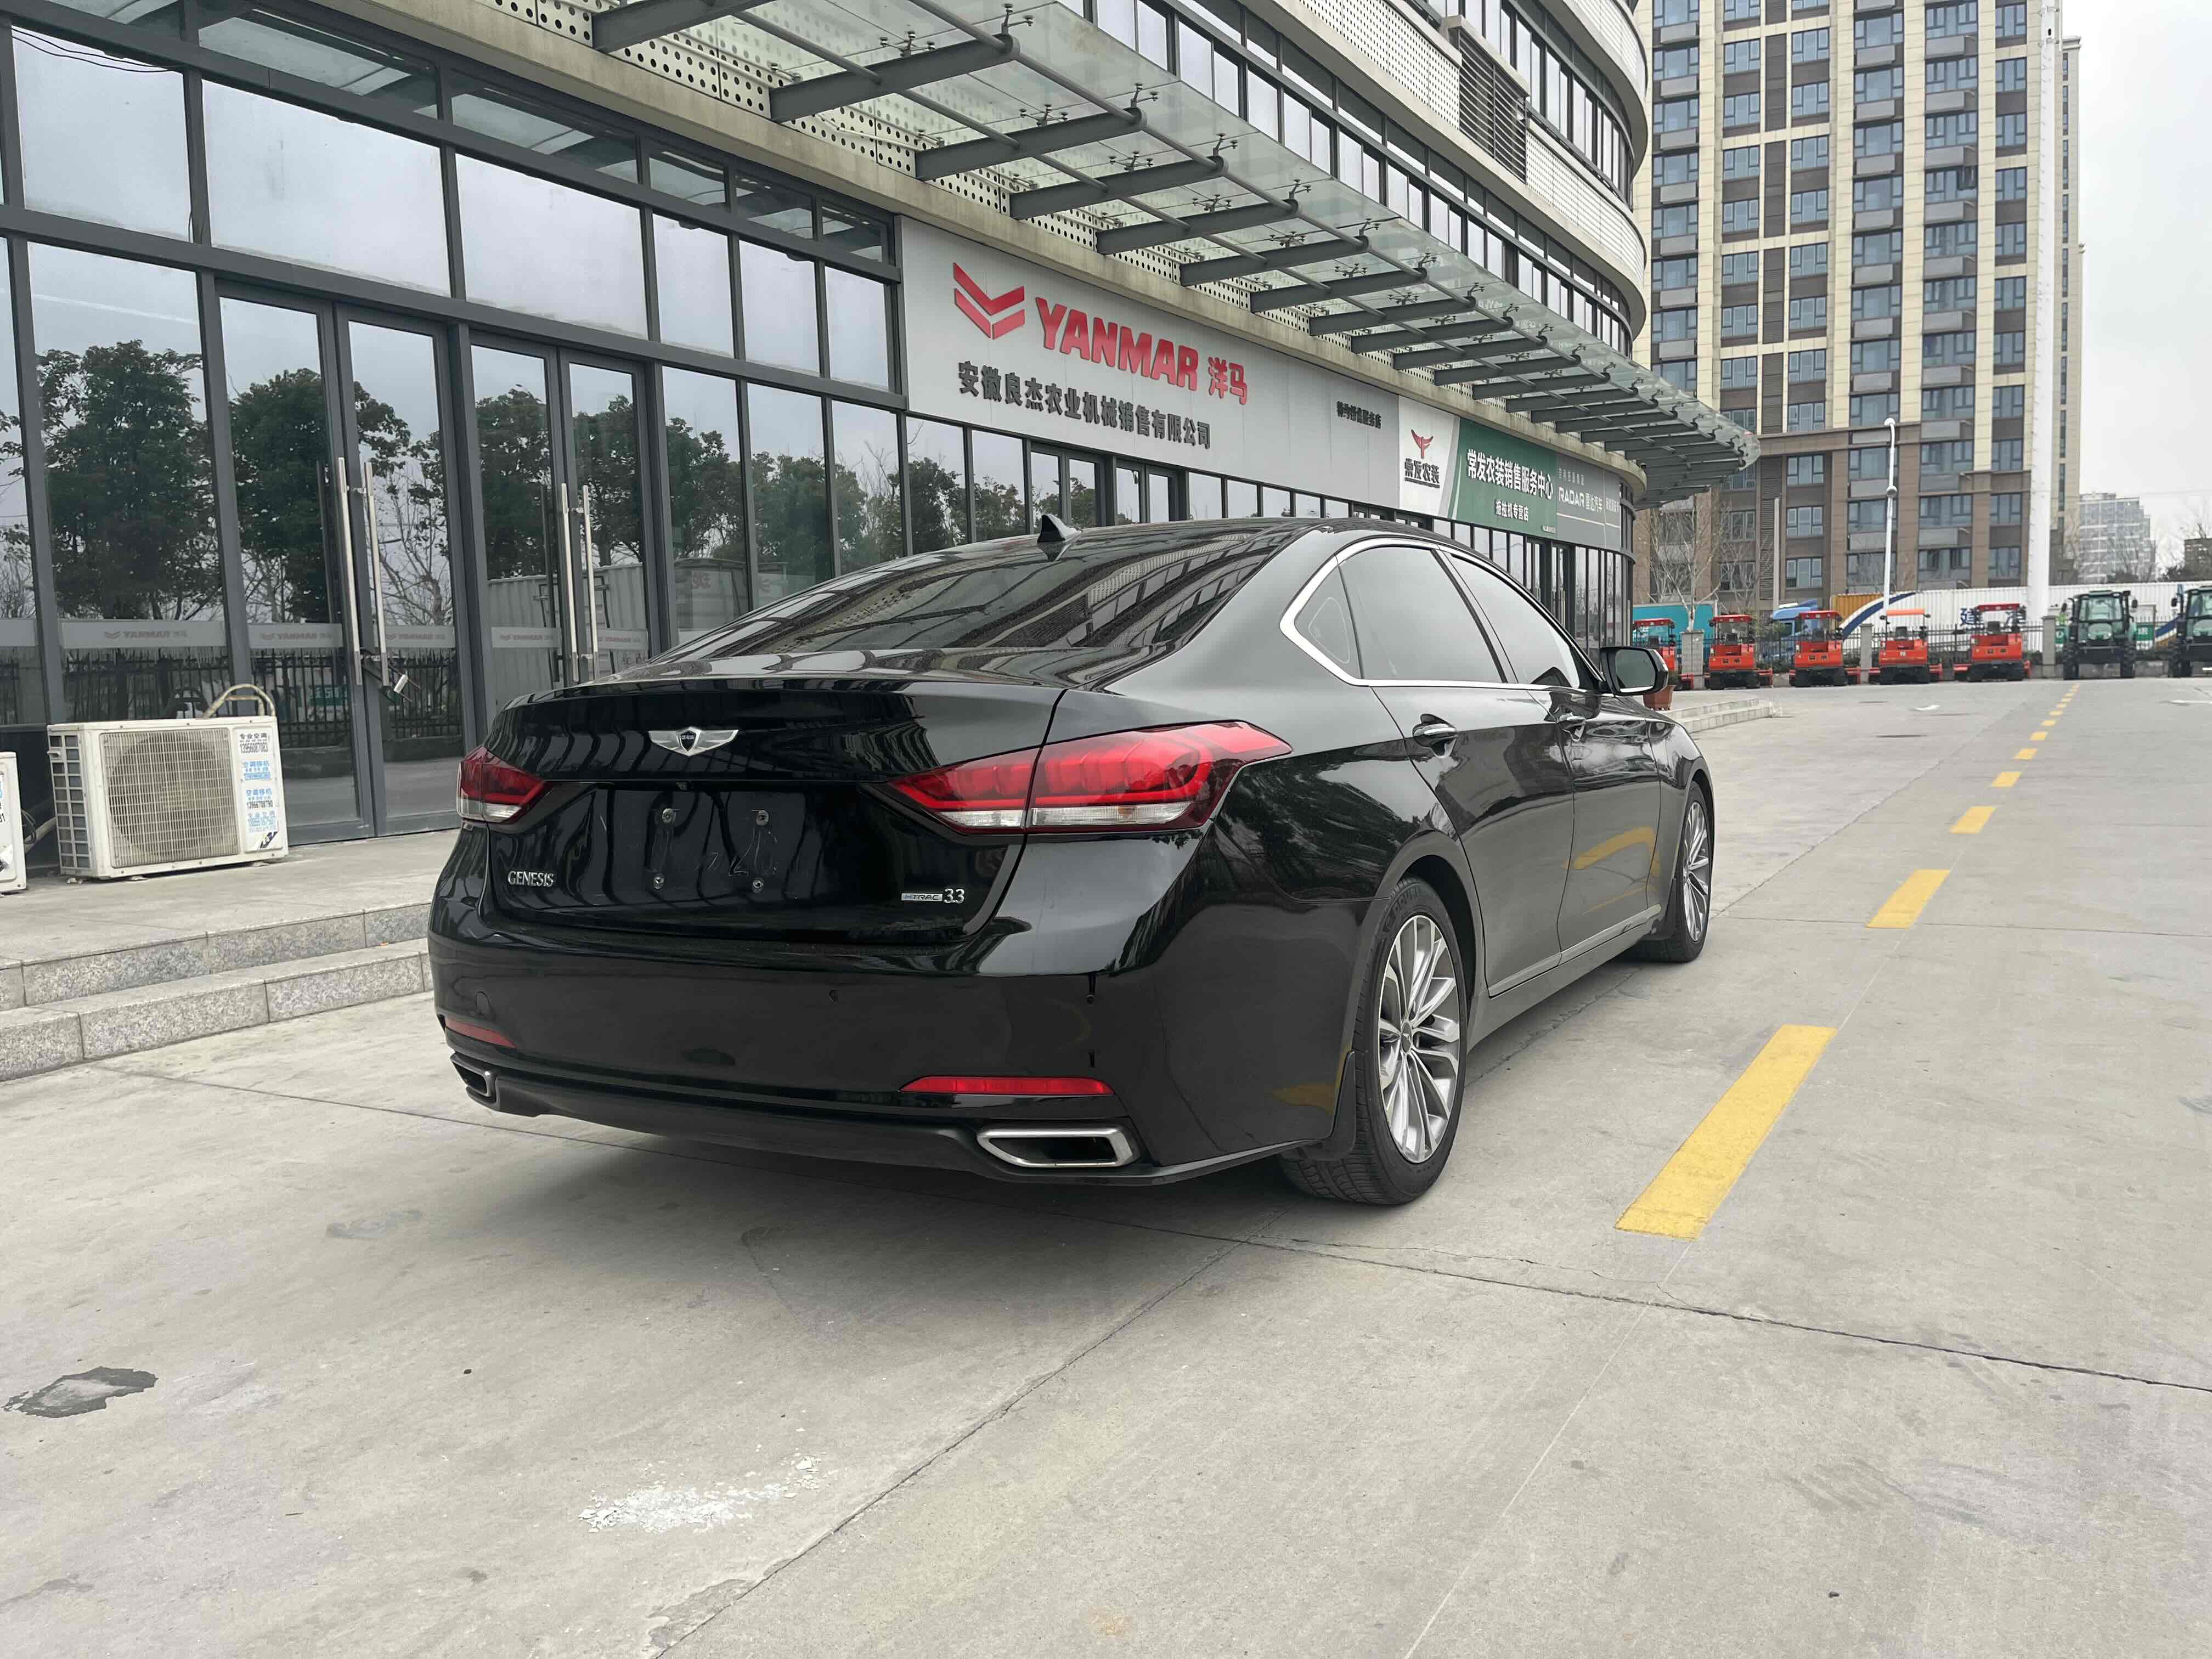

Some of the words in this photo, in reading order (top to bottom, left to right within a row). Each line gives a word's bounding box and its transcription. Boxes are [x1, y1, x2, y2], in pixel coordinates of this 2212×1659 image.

[1035, 296, 1199, 392] YANMAR
[1207, 356, 1248, 405] 洋马
[958, 360, 1211, 450] 安徽良杰农业机械销售有限公司
[1404, 458, 1440, 484] 常发农装
[1467, 448, 1554, 500] 常发农装销售服务中心
[1496, 498, 1529, 522] 拖拉机专营店
[1558, 487, 1585, 507] RADAR
[507, 871, 554, 887] GENESIS
